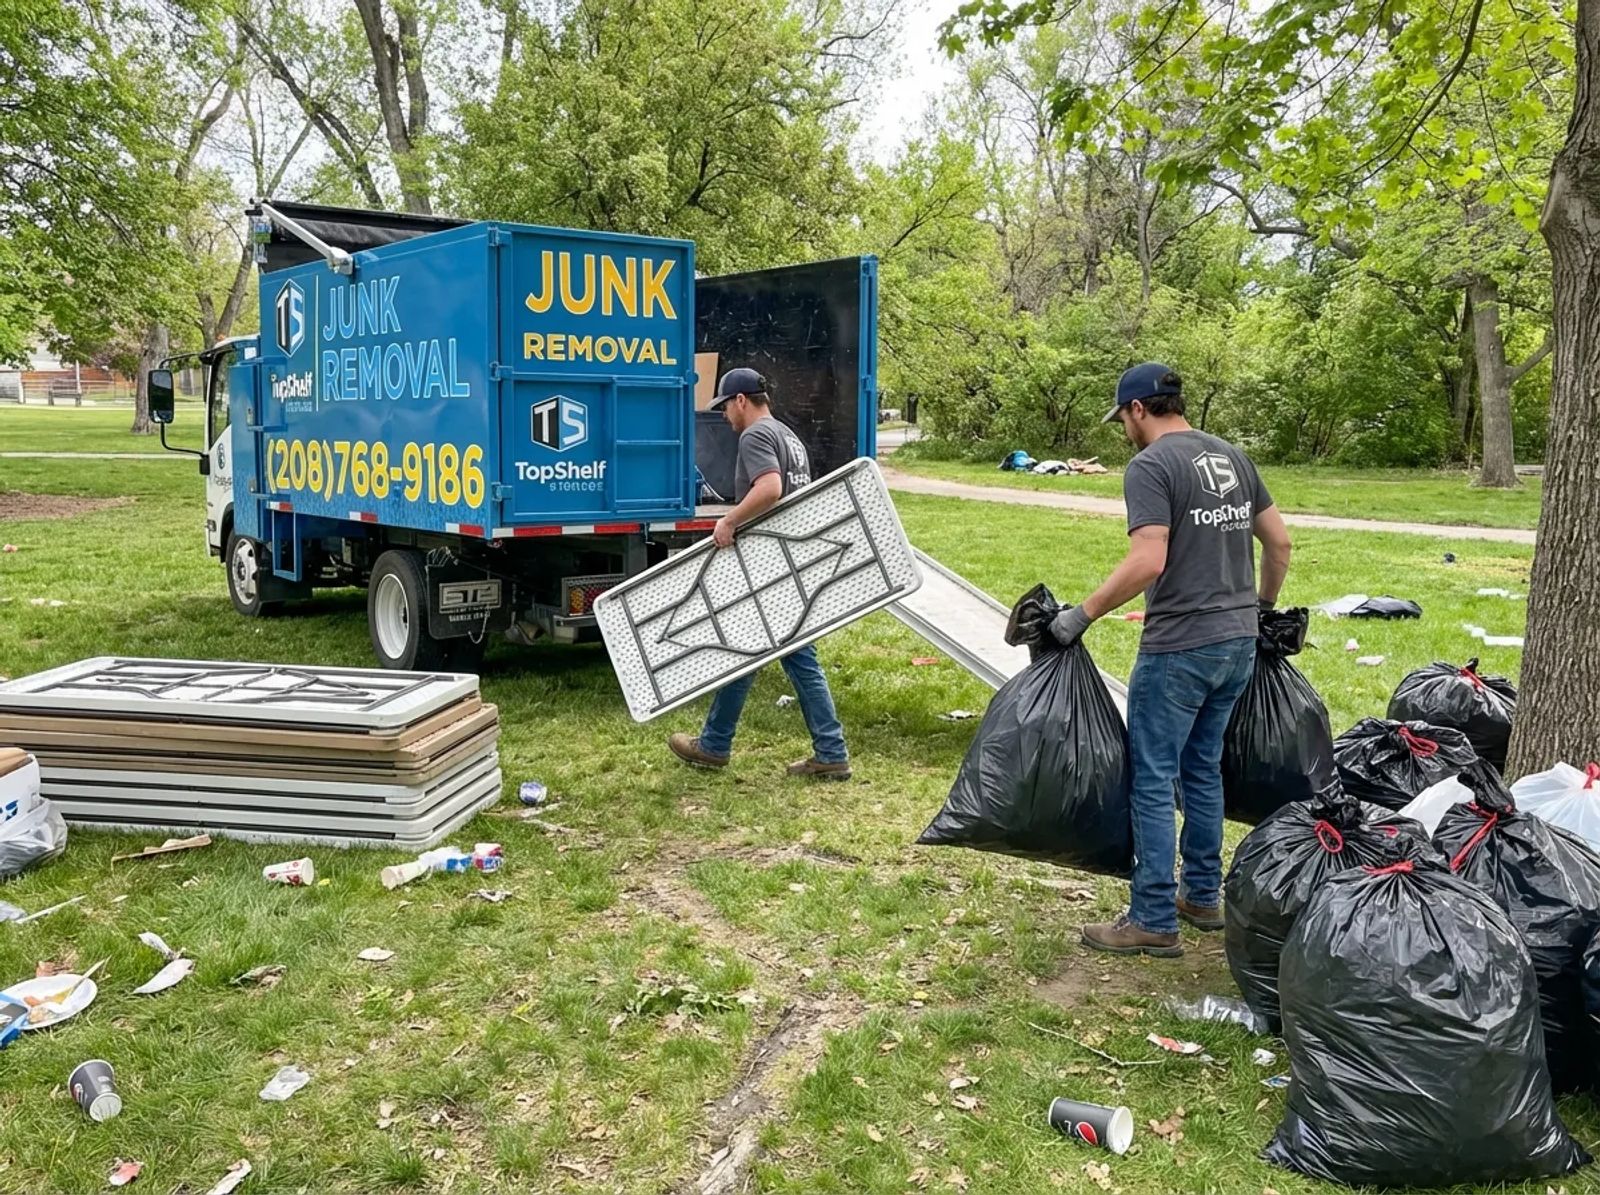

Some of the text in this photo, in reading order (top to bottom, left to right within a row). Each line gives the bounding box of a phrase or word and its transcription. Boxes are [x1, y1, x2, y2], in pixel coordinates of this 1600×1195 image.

[322, 275, 402, 341] JUNK
[525, 250, 678, 320] JUNK
[322, 338, 471, 401] REMOVAL
[523, 332, 678, 365] REMOVAL
[533, 400, 586, 445] TS
[267, 439, 485, 509] (208)768-9186
[515, 460, 607, 484] TopShelf
